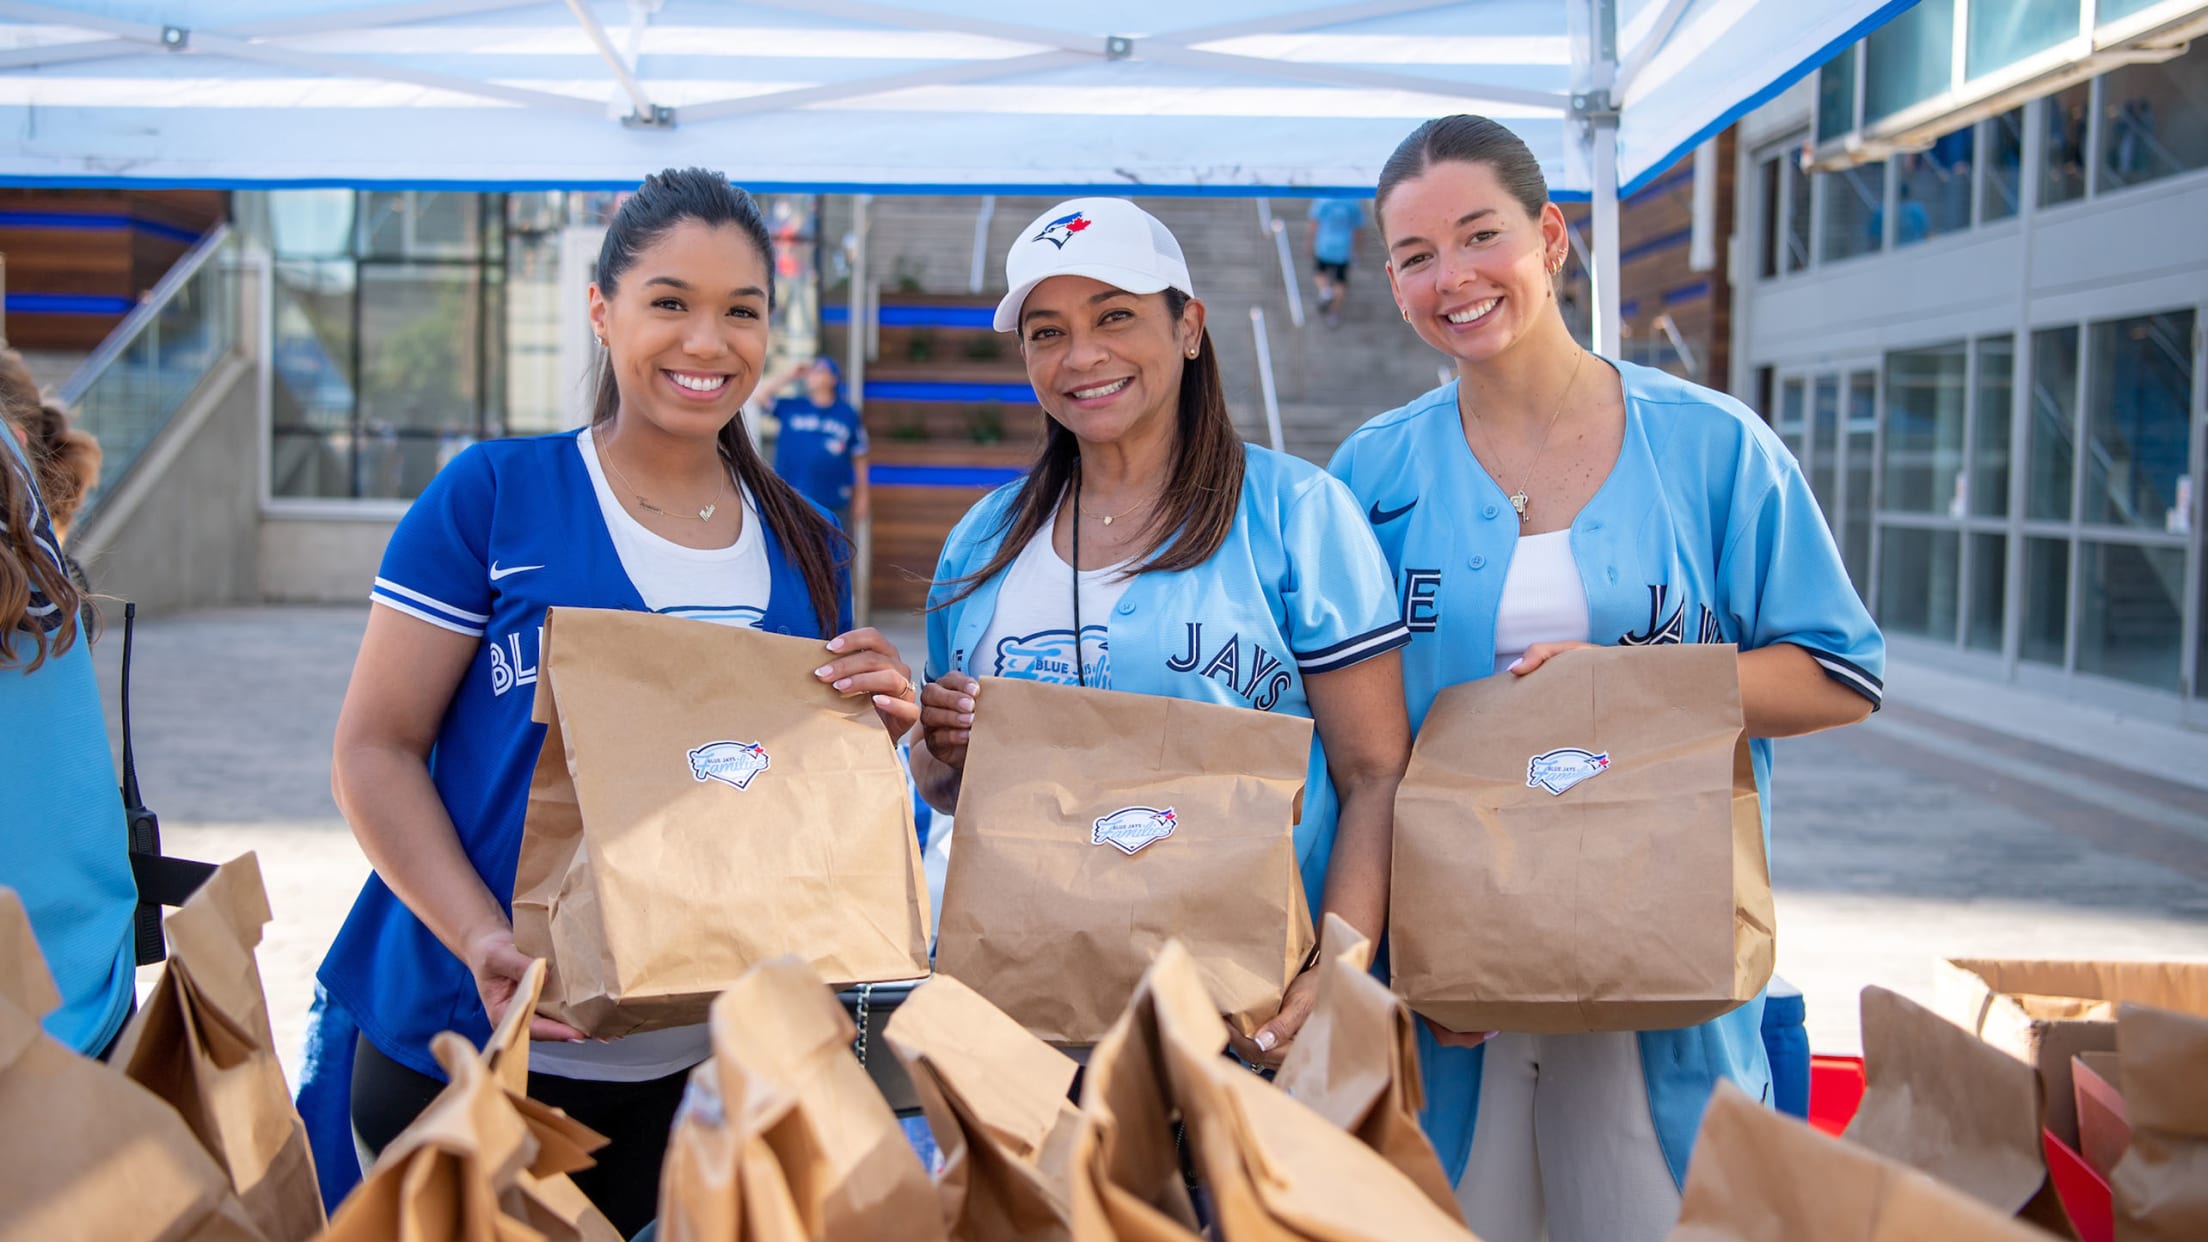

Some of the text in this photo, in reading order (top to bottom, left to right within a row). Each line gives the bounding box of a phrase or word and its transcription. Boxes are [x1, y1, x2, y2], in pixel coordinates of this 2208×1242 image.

[490, 626, 544, 697] BL
[1035, 659, 1069, 674] BLUE
[1165, 622, 1292, 711] JAYS
